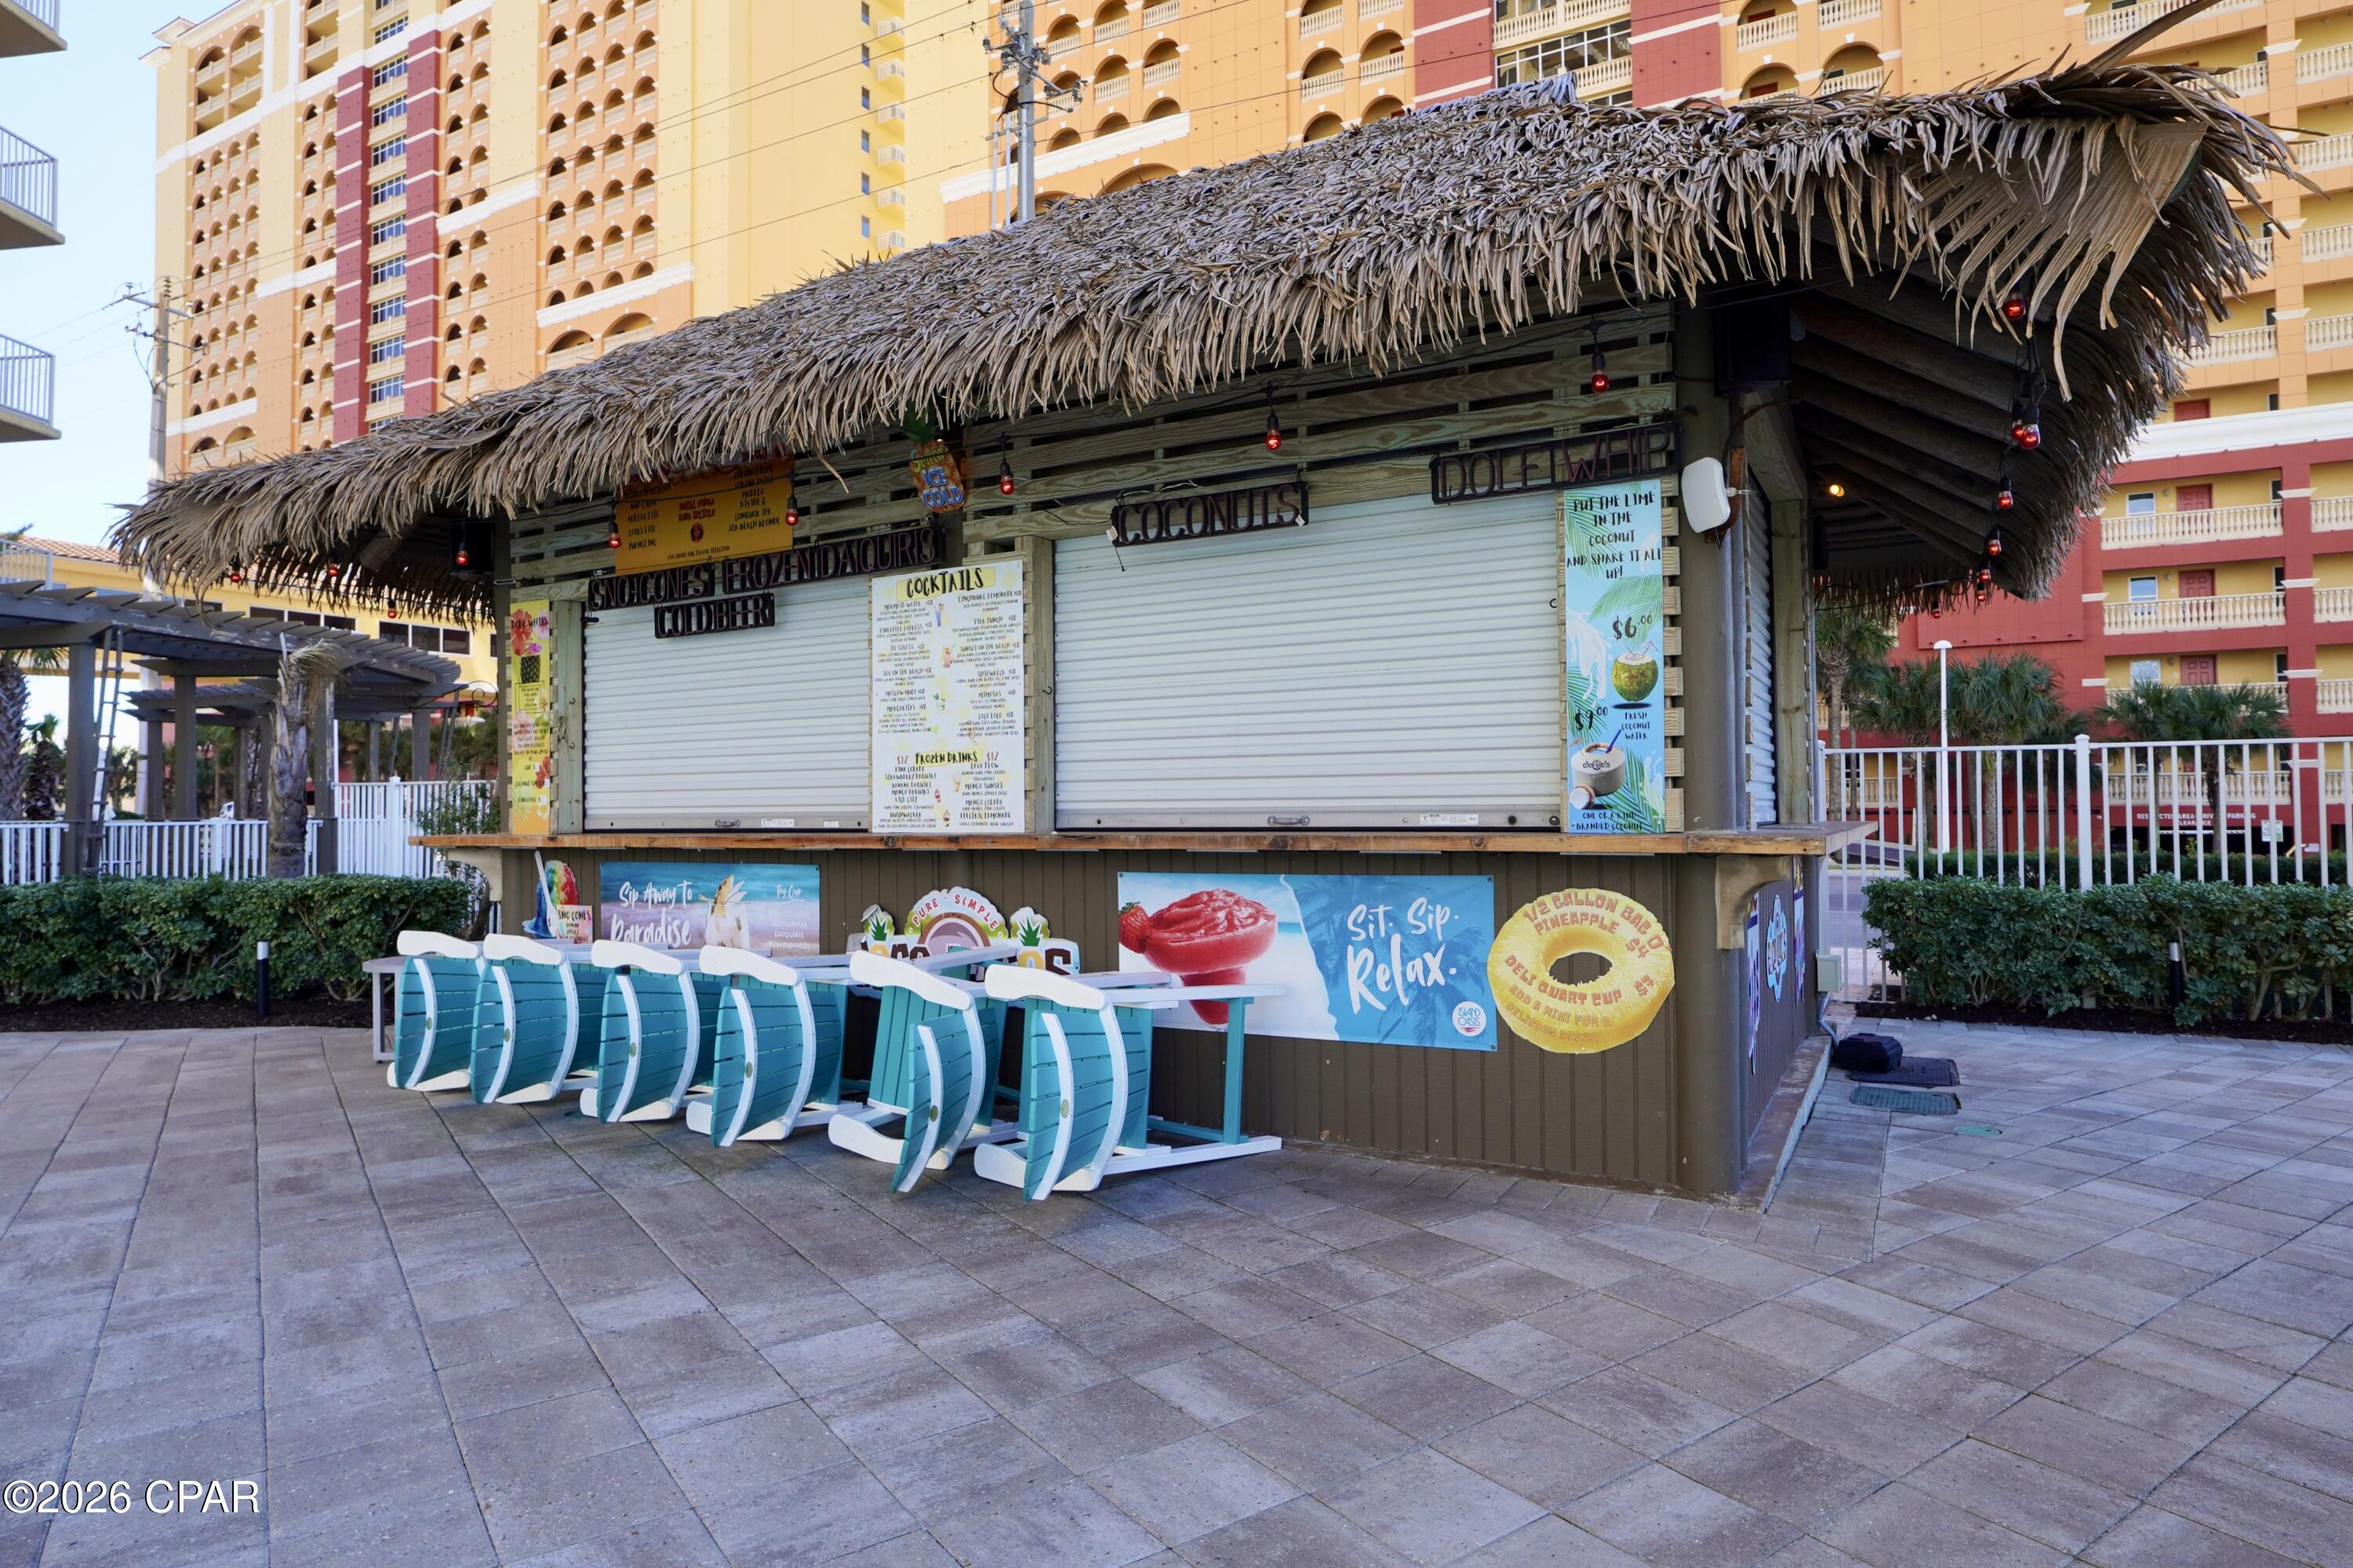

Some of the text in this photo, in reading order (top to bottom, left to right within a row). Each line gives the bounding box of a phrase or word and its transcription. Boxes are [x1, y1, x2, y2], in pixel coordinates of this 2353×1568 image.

[1440, 427, 1669, 500] DOLE WHIP
[922, 466, 947, 486] ICE
[922, 485, 964, 508] COLD
[1573, 491, 1655, 512] PUT THE LIME
[1119, 484, 1300, 544] COCONUTS
[1593, 511, 1631, 527] IN THE
[1589, 529, 1635, 547] COCONUT
[726, 549, 811, 592] FROZEN
[814, 528, 936, 580] DAIQUIRIS
[1566, 548, 1662, 568] AND SHAKE IT ALL
[907, 568, 984, 598] COCKTAILS
[1606, 565, 1623, 580] UP!
[658, 594, 768, 638] COLD BEER
[1621, 721, 1650, 730] COCONUT
[915, 752, 946, 765] FROZEN
[947, 751, 978, 763] DRINKS
[1577, 822, 1610, 831] BRANDED
[620, 881, 639, 910] Sip
[644, 882, 677, 910] Away
[775, 884, 787, 899] Try
[558, 910, 591, 921] SNO CONES
[911, 894, 999, 930] PURE SIMPLE
[1347, 897, 1460, 941] Sit. Sip.
[1522, 900, 1551, 923] 1/2
[1551, 890, 1619, 914] GALLON
[1620, 904, 1652, 935] BAG
[610, 907, 693, 949] Paradise
[1533, 911, 1620, 935] PINEAPPLE
[774, 930, 804, 939] DAIQUIRIS
[1346, 933, 1457, 1015] Relax.
[1504, 954, 1536, 987] DELI
[1537, 980, 1587, 1005] QUART
[1591, 988, 1623, 1006] CUP
[1508, 984, 1531, 1005] ADD
[1458, 1007, 1481, 1017] ISLAND
[1458, 1017, 1481, 1027] OASIS
